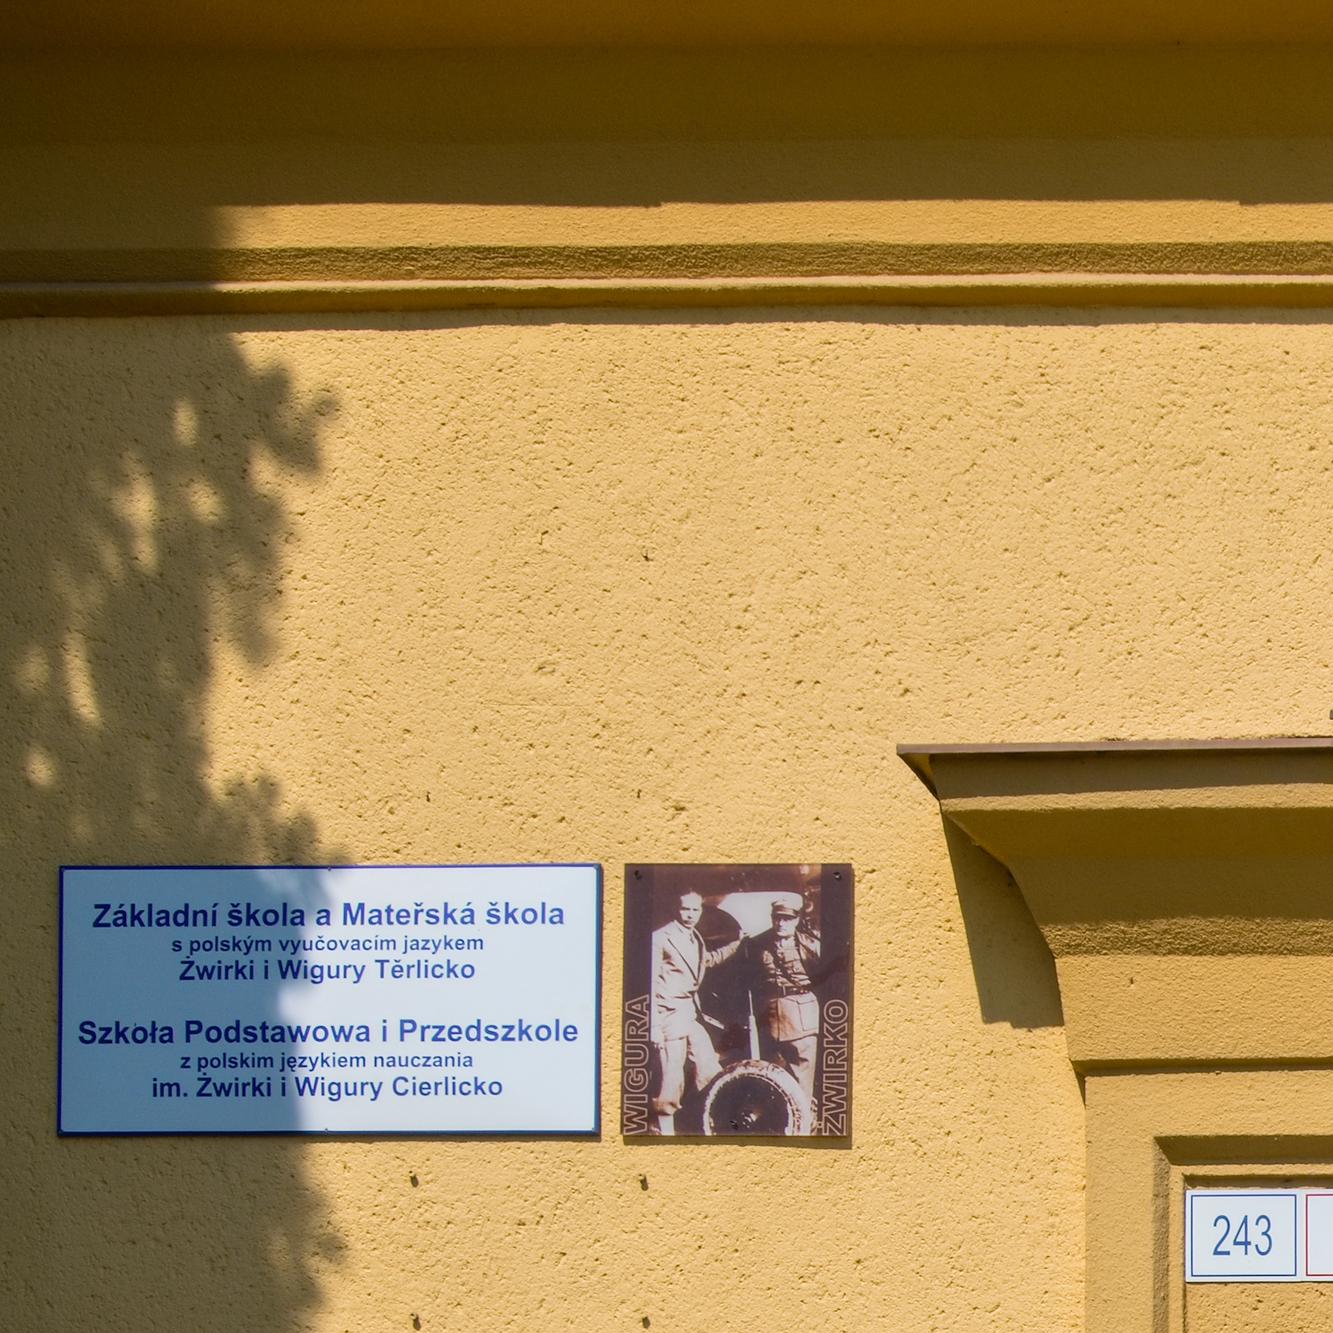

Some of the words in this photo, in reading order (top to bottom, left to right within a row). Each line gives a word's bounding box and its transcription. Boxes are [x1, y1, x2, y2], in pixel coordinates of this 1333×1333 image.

[93, 903, 218, 928] Základní
[228, 903, 305, 926] škola
[316, 910, 331, 925] a
[342, 903, 475, 926] Mateřská
[485, 903, 564, 925] škola
[172, 939, 182, 952] s
[189, 935, 272, 955] polským
[279, 934, 397, 955] vyučovacím
[402, 934, 484, 954] jazykem
[180, 956, 254, 981] Żwirki
[264, 960, 269, 980] i
[278, 959, 365, 984] Wigury
[375, 959, 475, 979] Těrlicko
[78, 1021, 174, 1044] Szkoła
[184, 1020, 371, 1043] Podstawowa
[382, 1019, 387, 1042] i
[400, 1019, 578, 1042] Przedszkole
[181, 1056, 191, 1069] z
[198, 1052, 273, 1073] polskim
[280, 1052, 366, 1073] językiem
[374, 1053, 473, 1068] nauczania
[623, 995, 650, 1135] WIGURA
[816, 999, 848, 1135] ŻWIRKO
[153, 1077, 188, 1098] im.
[196, 1072, 272, 1098] Żwirki
[281, 1077, 286, 1097] i
[295, 1076, 382, 1102] Wigury
[392, 1076, 503, 1097] Cierlicko
[1213, 1215, 1272, 1256] 243
